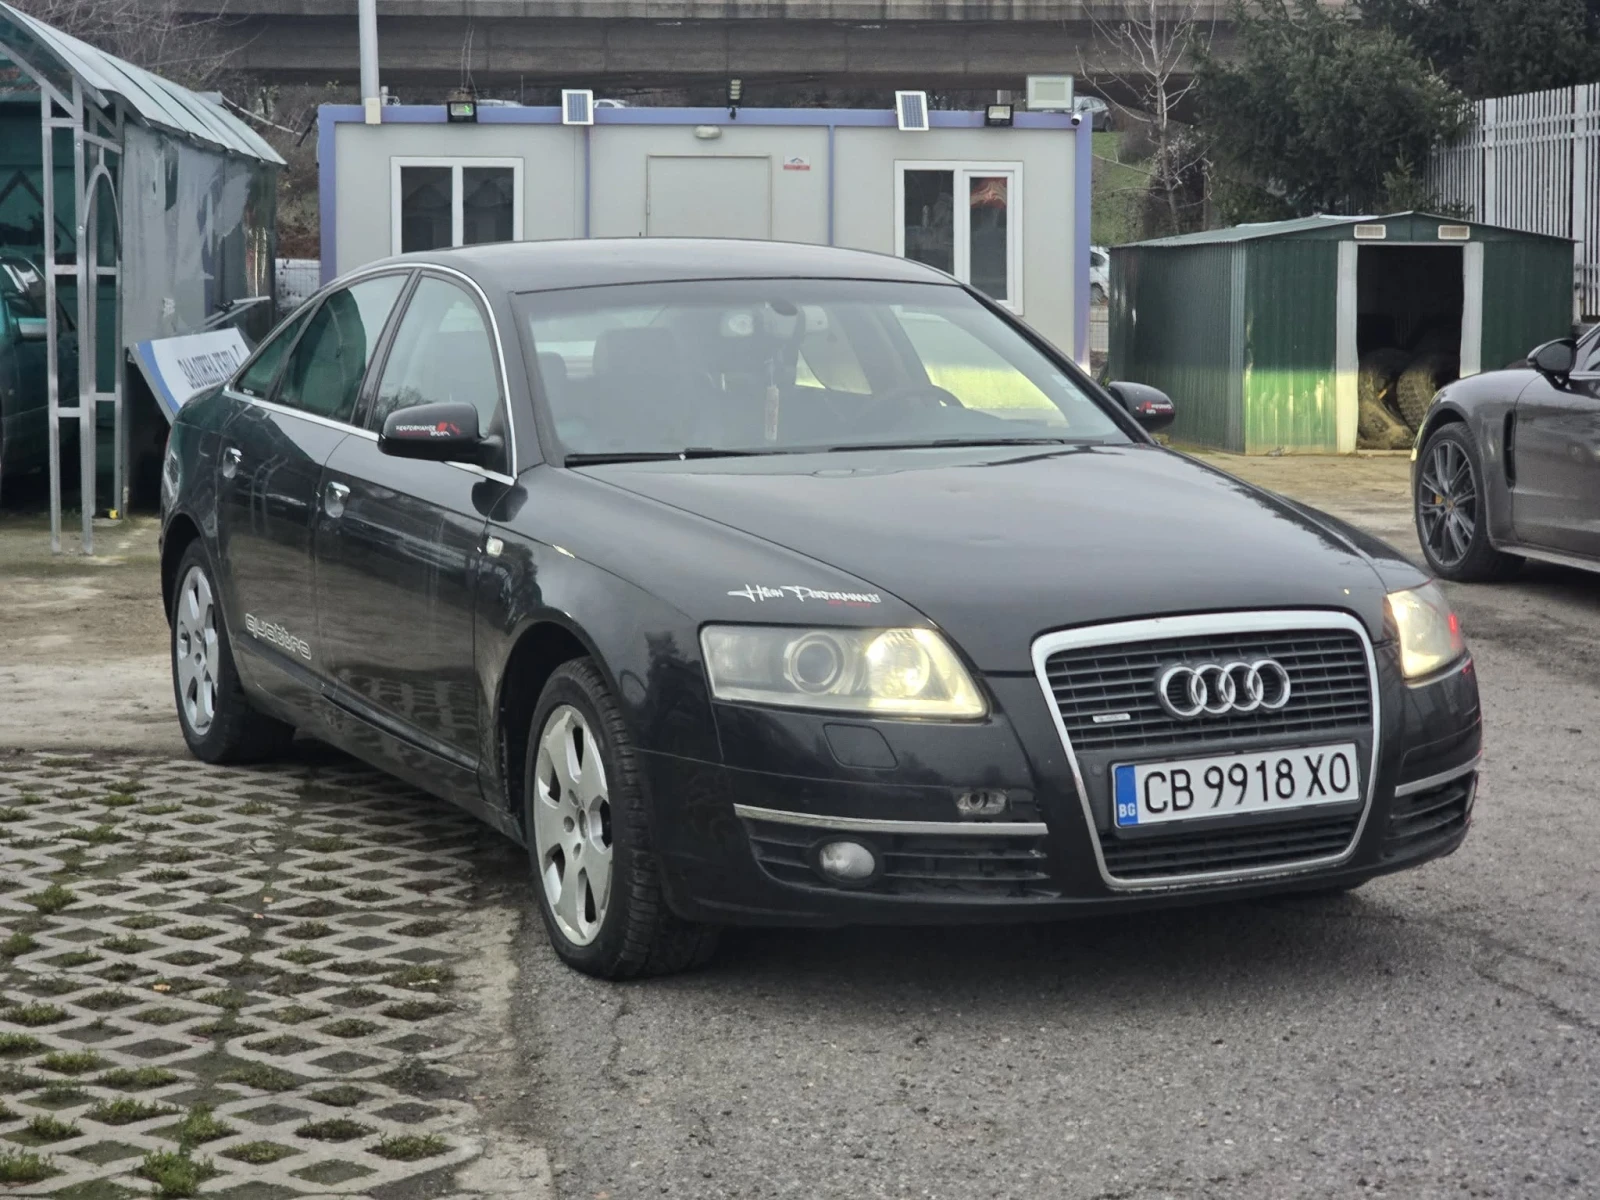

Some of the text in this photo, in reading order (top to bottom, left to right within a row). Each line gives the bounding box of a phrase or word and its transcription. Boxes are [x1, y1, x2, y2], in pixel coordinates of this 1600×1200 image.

[245, 613, 311, 660] quattro
[1144, 752, 1350, 813] CB 9918 XO
[1119, 803, 1136, 818] BG
